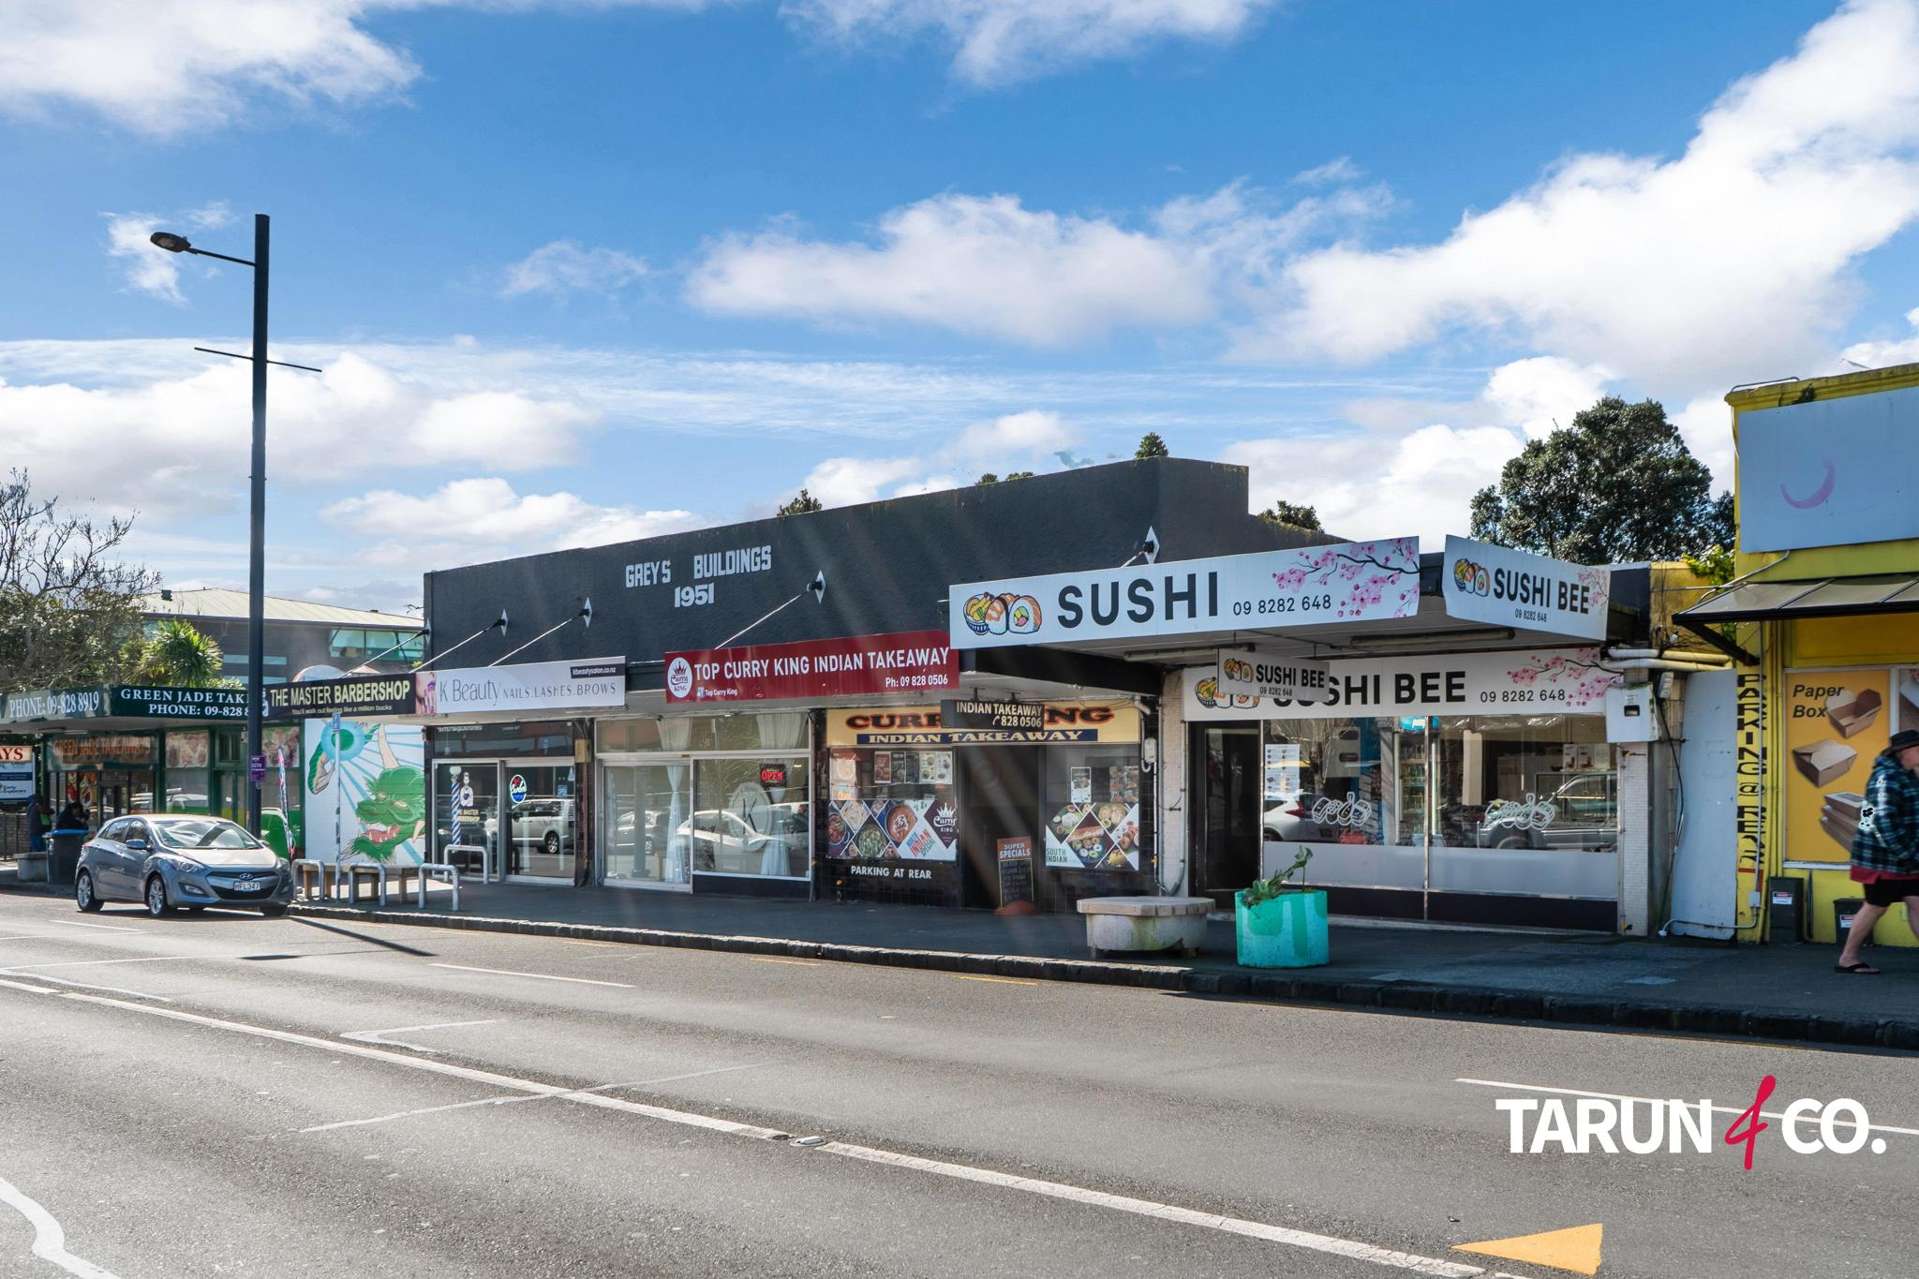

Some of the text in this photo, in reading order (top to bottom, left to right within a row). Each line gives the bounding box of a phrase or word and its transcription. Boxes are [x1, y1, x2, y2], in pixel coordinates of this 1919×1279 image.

[625, 545, 772, 588] GREYS BUILDINGS
[674, 582, 715, 608] 1951
[1493, 567, 1590, 614] SUSHI BEE
[1057, 571, 1331, 628] SUSHI 09 8282 648
[694, 646, 950, 680] TOP CURRY KING INDIAN TAKEAWAY
[885, 674, 948, 688] Ph: 09 828 0506
[1255, 663, 1325, 689] SUSHI BEE
[271, 680, 411, 707] THE MASTER BARBERSHOP
[440, 681, 449, 702] K
[452, 679, 499, 706] Beauty
[1394, 670, 1466, 704] BEE
[1480, 691, 1497, 703] 09
[1502, 690, 1534, 702] 8282
[1540, 689, 1566, 701] 648
[1792, 684, 1845, 701] Paper
[10, 690, 99, 718] PHONE: 09-828 8919
[120, 688, 249, 704] GREEN JADE TAK
[148, 704, 200, 716] PHONE:
[204, 705, 243, 717] 09-828
[956, 702, 1043, 716] INDIAN TAKEAWAY
[1792, 705, 1827, 719] Box
[1001, 716, 1042, 728] 828 0506
[868, 730, 1083, 744] INDIAN TAKEAWAY
[1000, 849, 1032, 859] SPECIALS
[1003, 842, 1026, 850] SUPER
[850, 865, 932, 879] PARKING AT REAR
